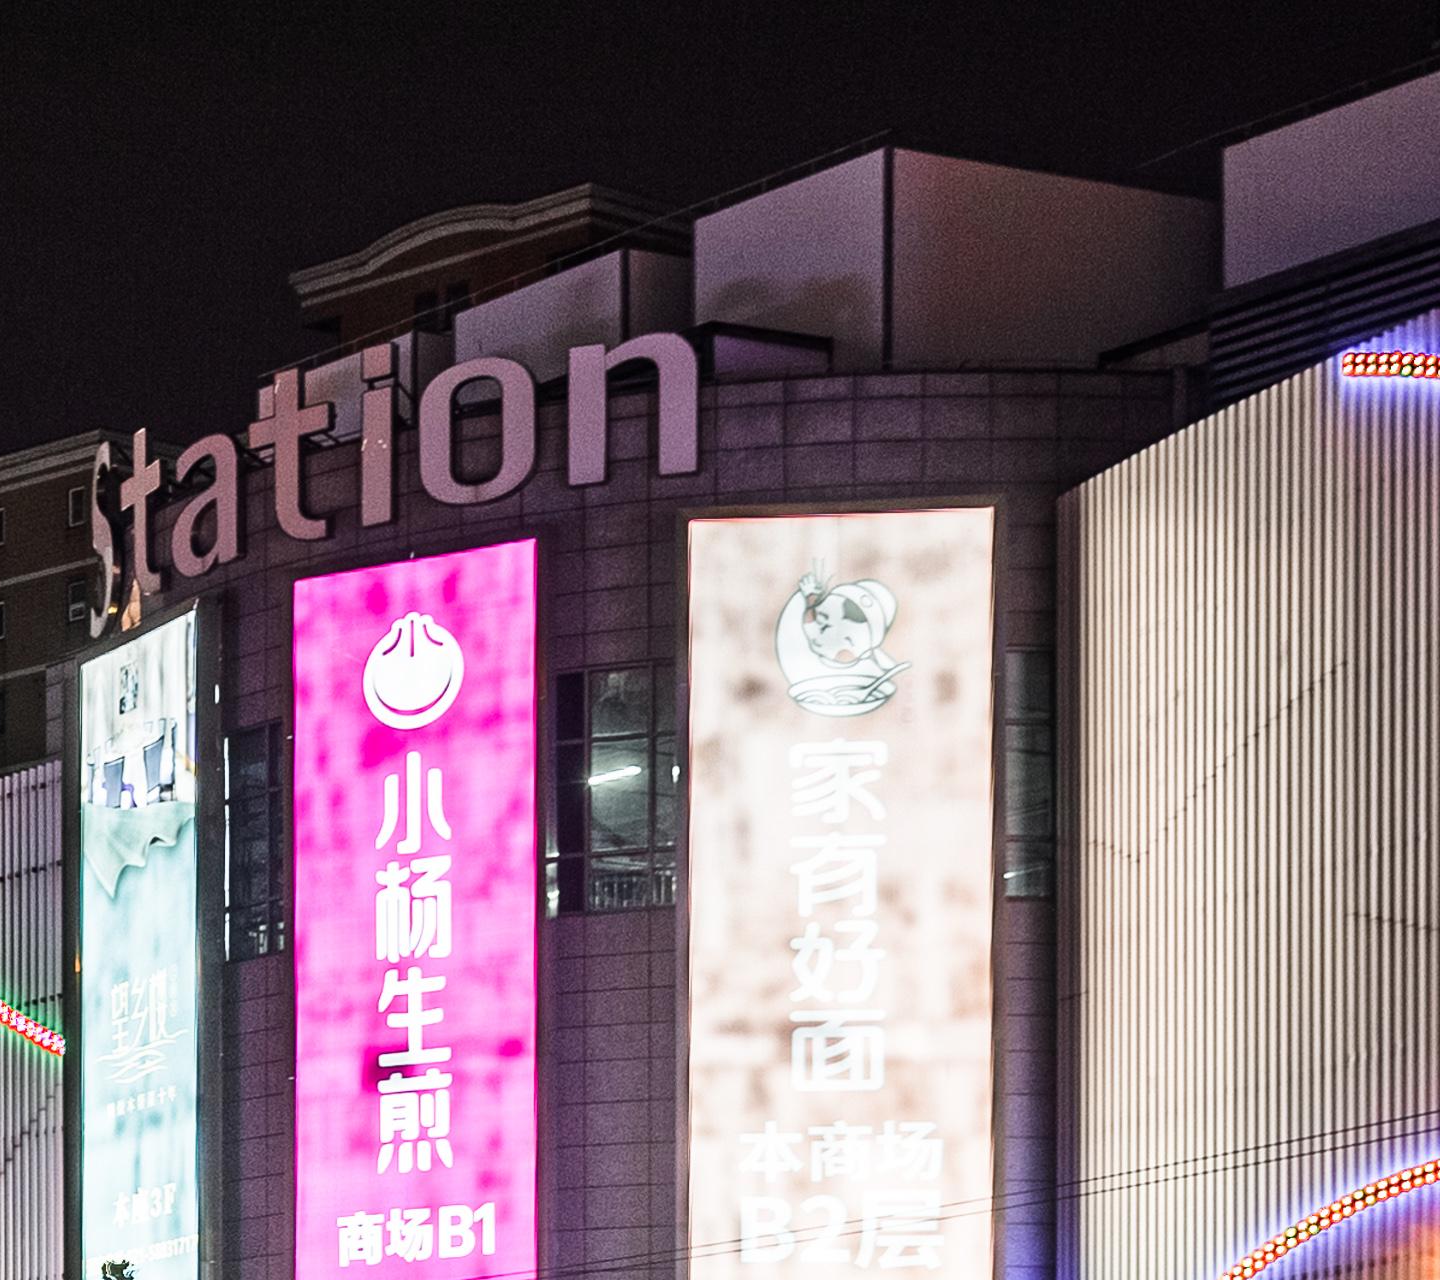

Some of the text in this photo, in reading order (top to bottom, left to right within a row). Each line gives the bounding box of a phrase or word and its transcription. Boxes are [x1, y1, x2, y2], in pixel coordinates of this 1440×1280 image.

[90, 331, 699, 639] Station
[374, 750, 454, 1174] 小杨生煎
[788, 737, 888, 1093] 家有好面
[336, 1202, 497, 1268] 商场B1
[737, 1119, 945, 1185] 本商场
[738, 1189, 945, 1271] B2层
